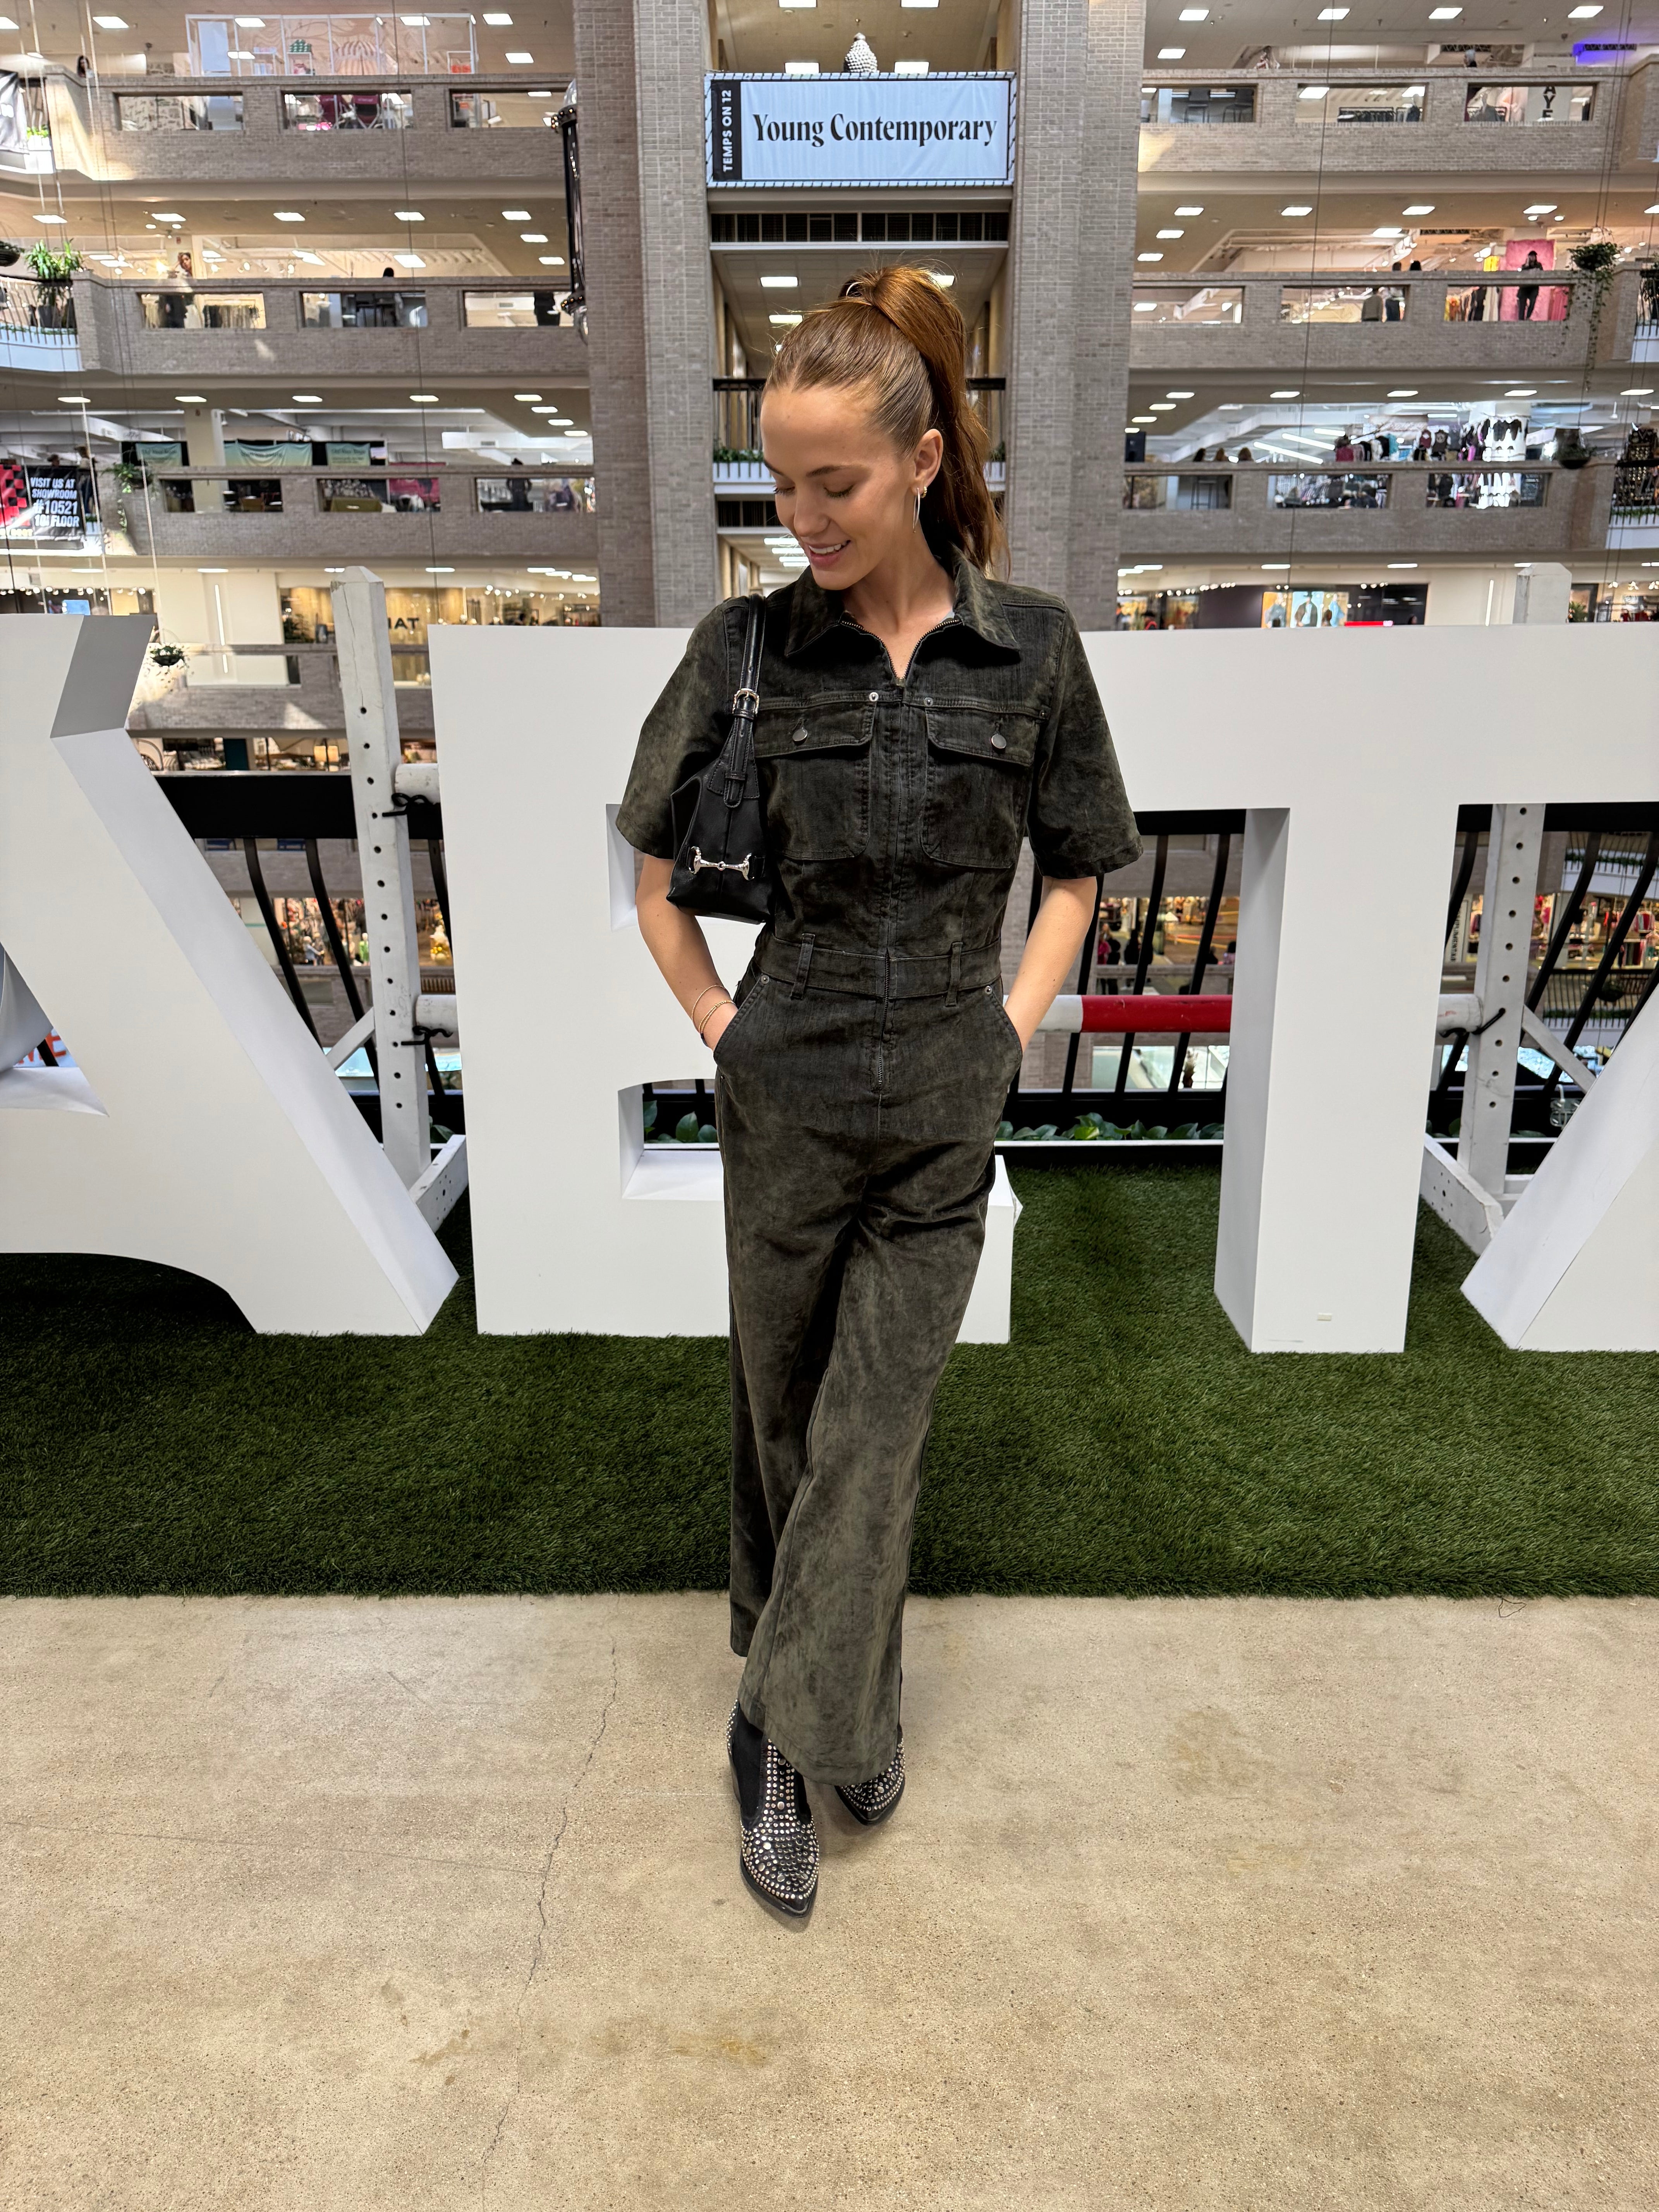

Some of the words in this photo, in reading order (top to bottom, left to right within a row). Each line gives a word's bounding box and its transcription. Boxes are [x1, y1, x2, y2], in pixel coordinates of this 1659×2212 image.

[721, 90, 731, 103] 12
[722, 106, 732, 126] ON
[752, 114, 824, 147] Young
[831, 113, 997, 147] Contemporary
[722, 130, 733, 172] TEMPS
[30, 477, 52, 488] VISIT
[52, 478, 64, 489] US
[65, 479, 75, 489] AT
[32, 488, 77, 500] SHOWROOM
[33, 499, 77, 515] #10521
[50, 515, 79, 527] FLOOR
